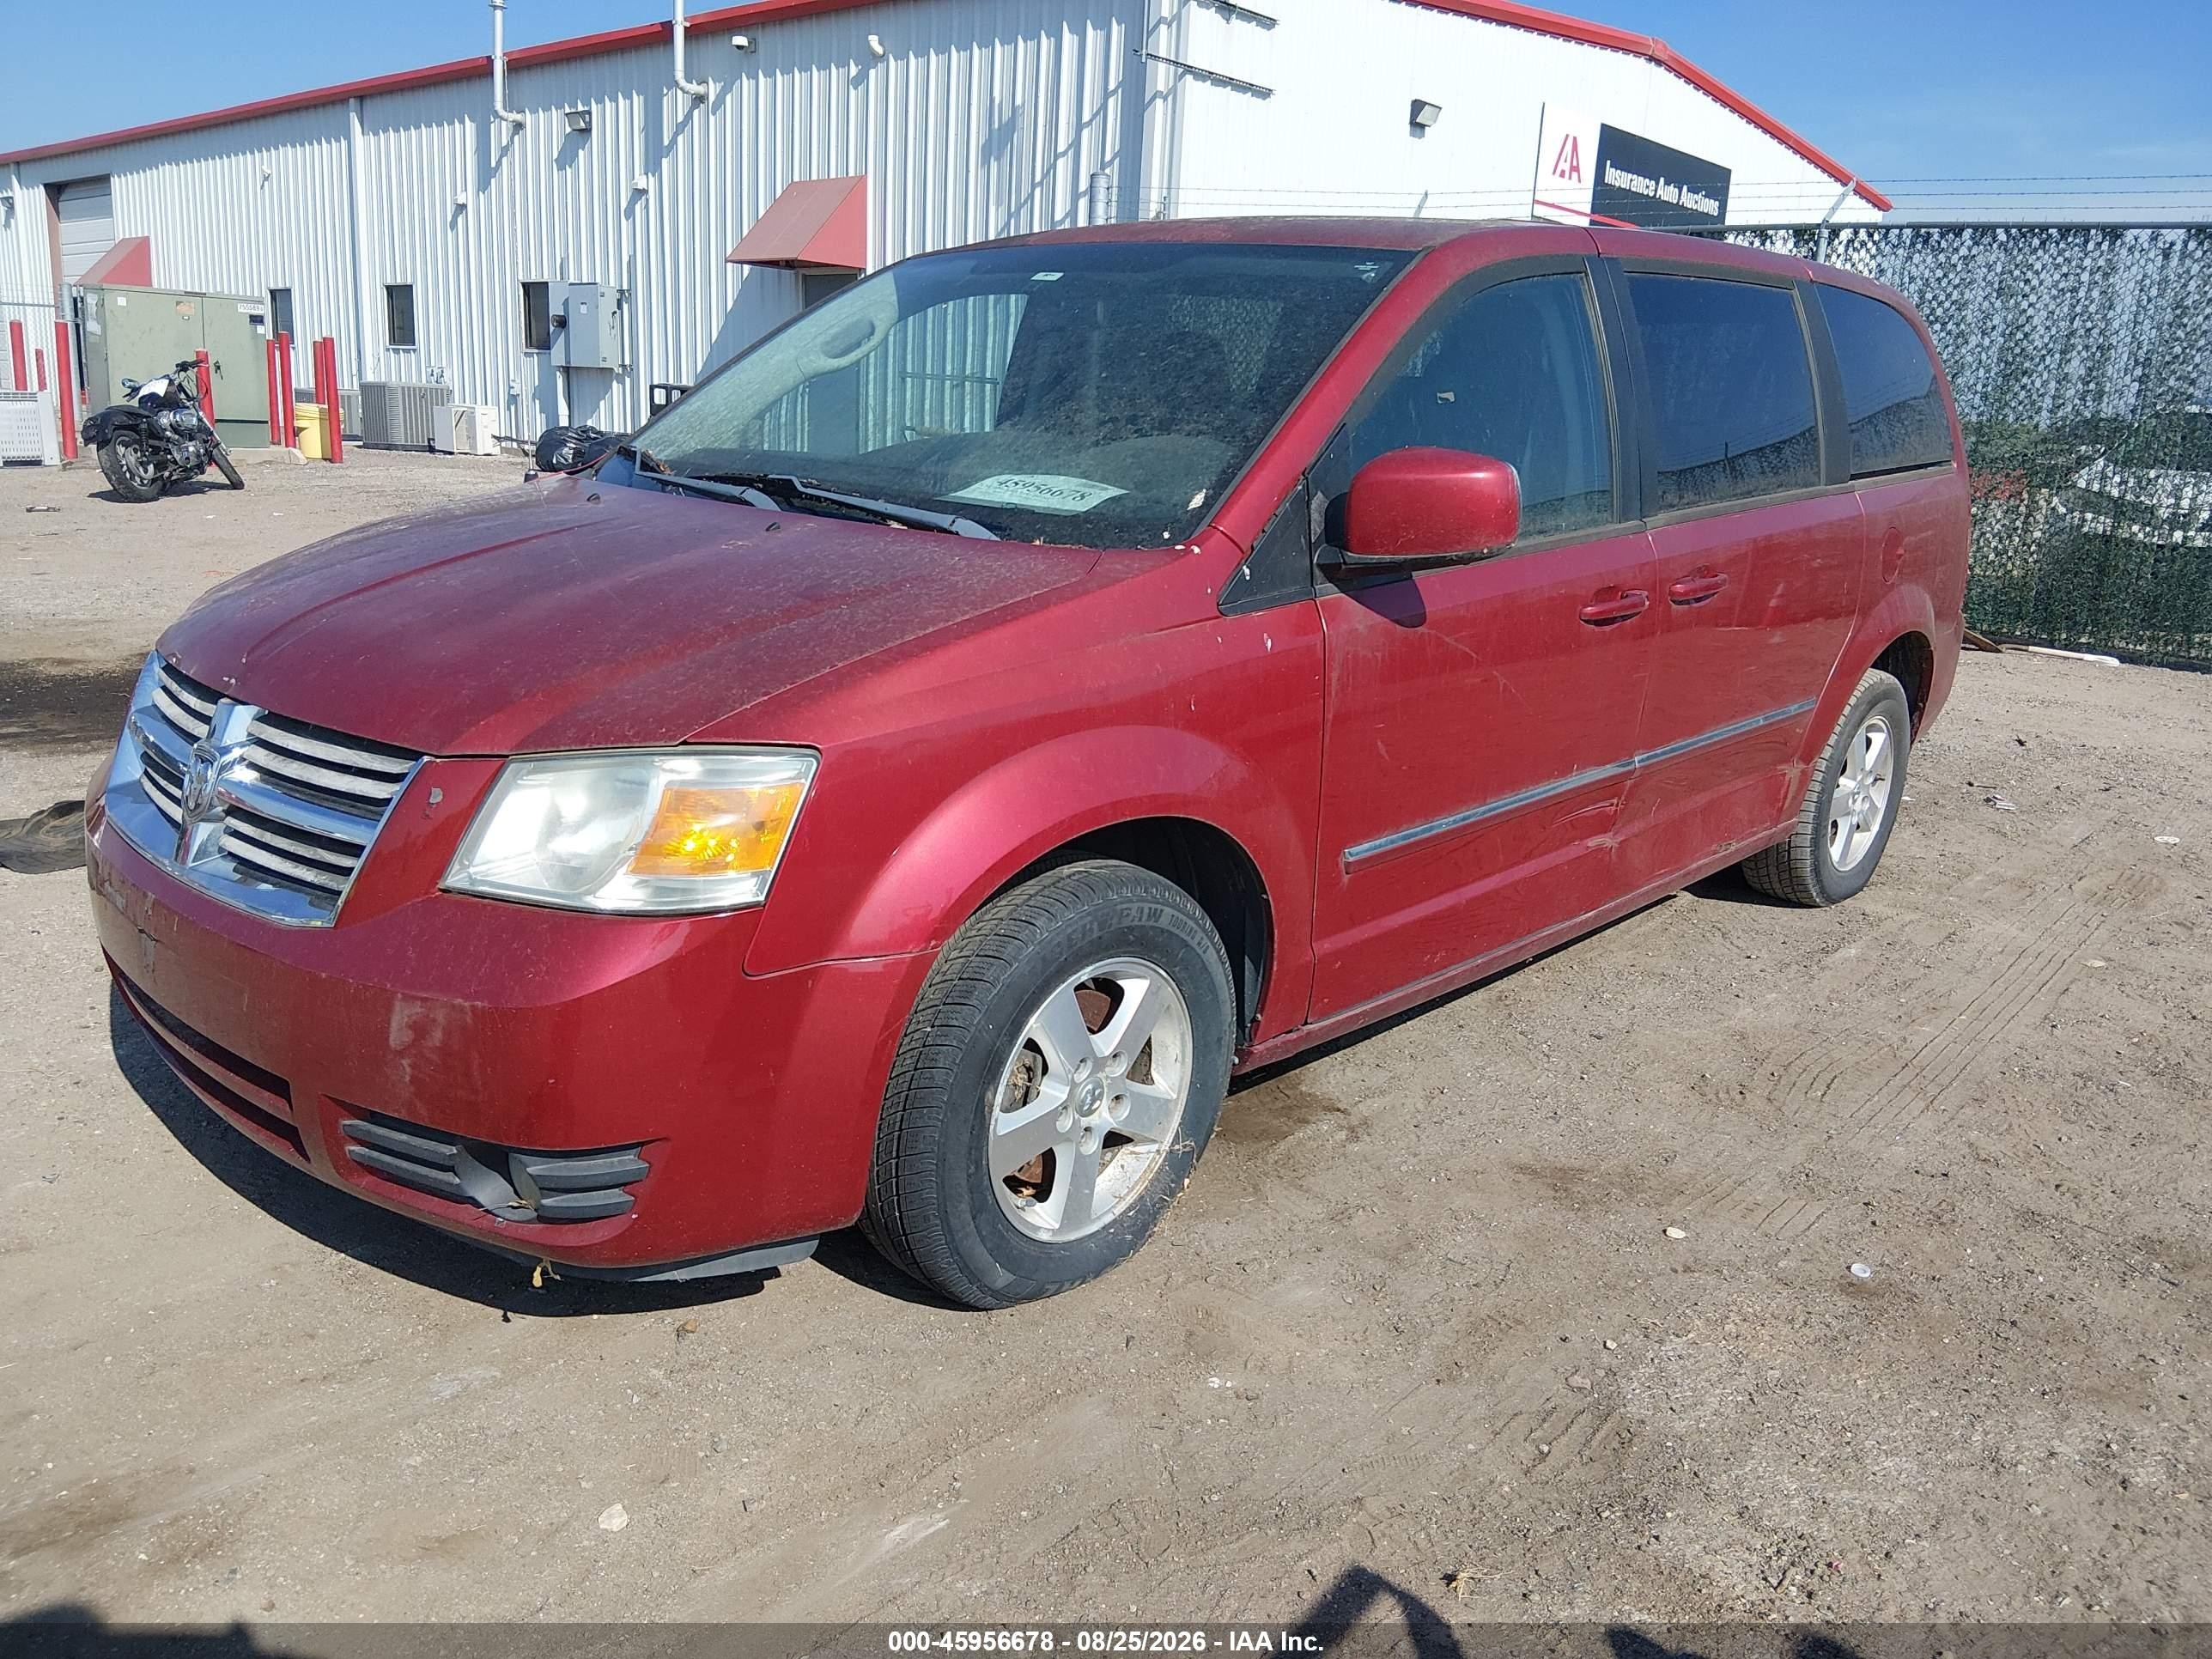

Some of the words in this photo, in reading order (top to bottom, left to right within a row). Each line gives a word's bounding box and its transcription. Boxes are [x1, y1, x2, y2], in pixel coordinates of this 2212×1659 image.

[1604, 160, 1656, 198] Insurance
[1656, 176, 1679, 204] Auto
[1679, 185, 1720, 216] Auctions
[997, 477, 1093, 501] 45956678
